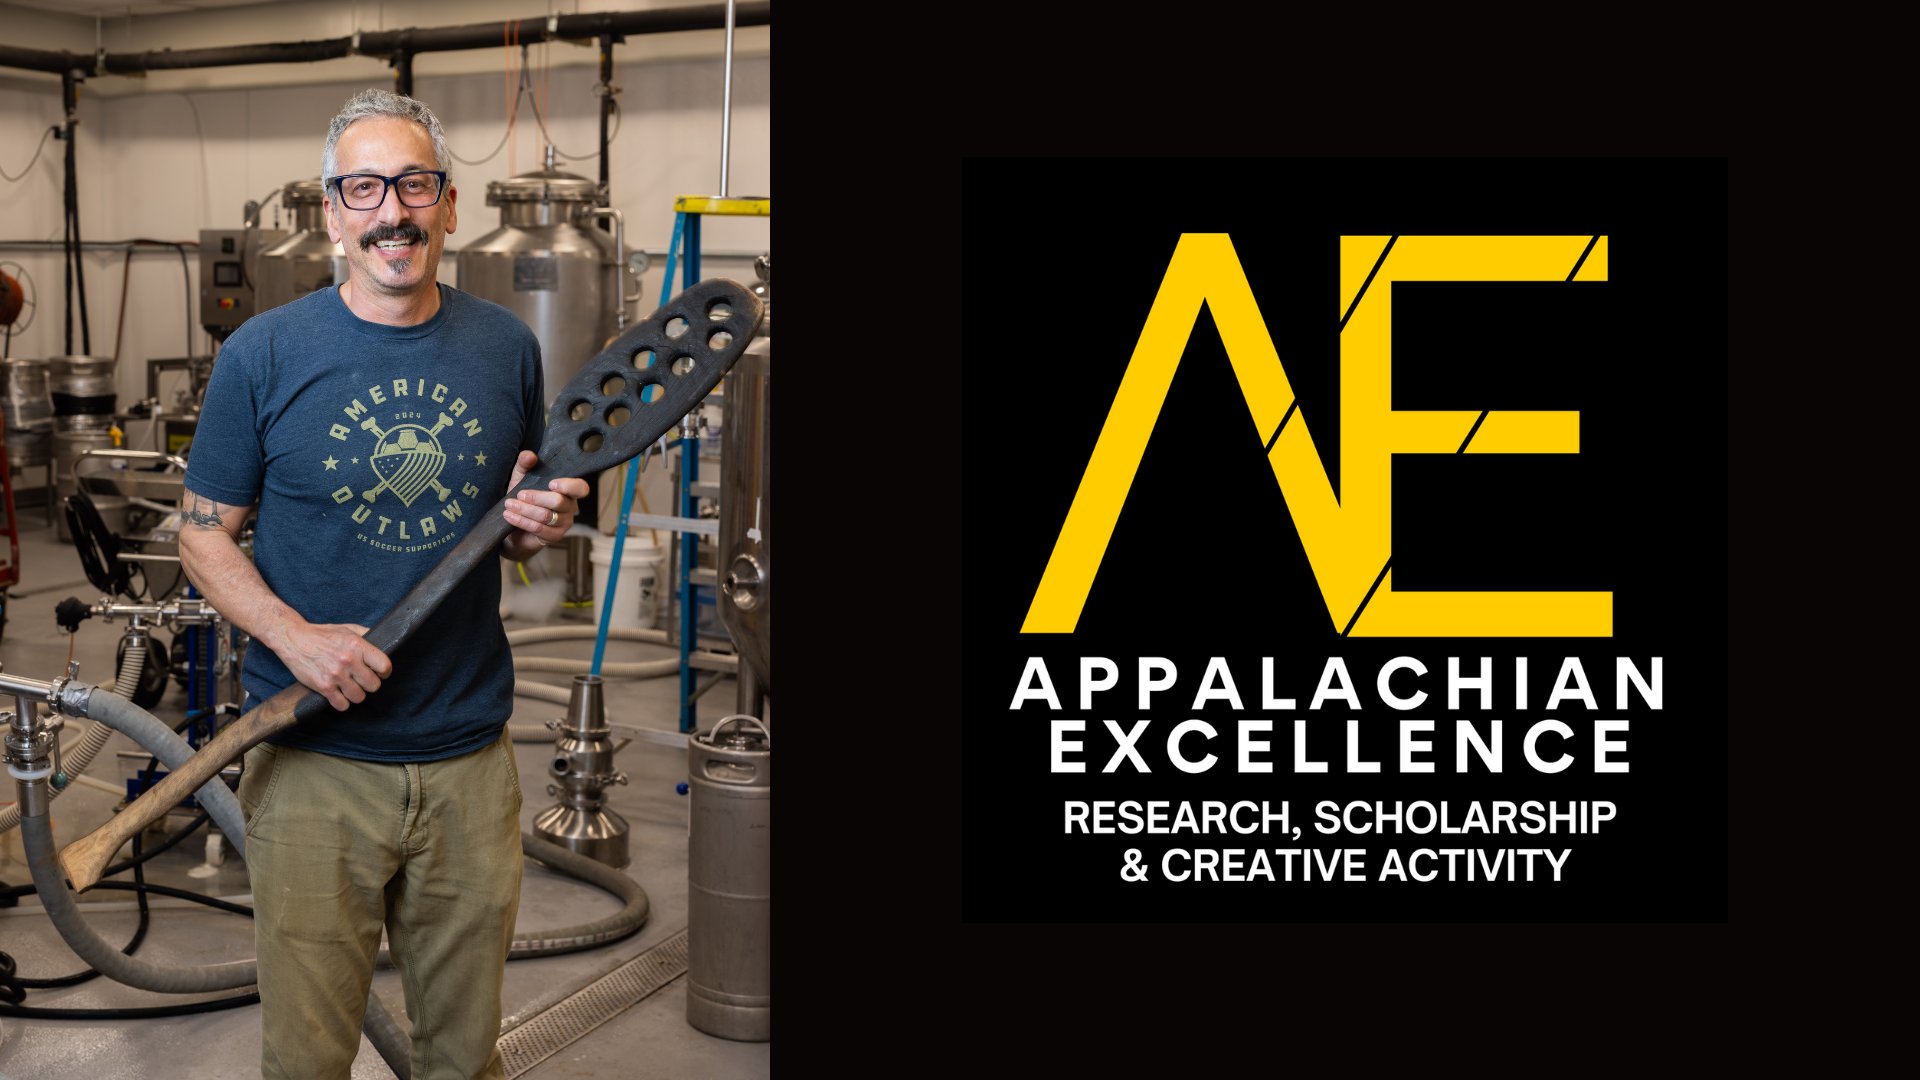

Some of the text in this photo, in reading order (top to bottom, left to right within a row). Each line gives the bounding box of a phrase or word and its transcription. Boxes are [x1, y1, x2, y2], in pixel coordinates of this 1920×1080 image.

[329, 378, 482, 441] AMERICAN
[395, 411, 421, 420] 2024
[331, 481, 480, 540] OUTLAWS
[356, 531, 456, 553] US SOCCER SUPPORTERS
